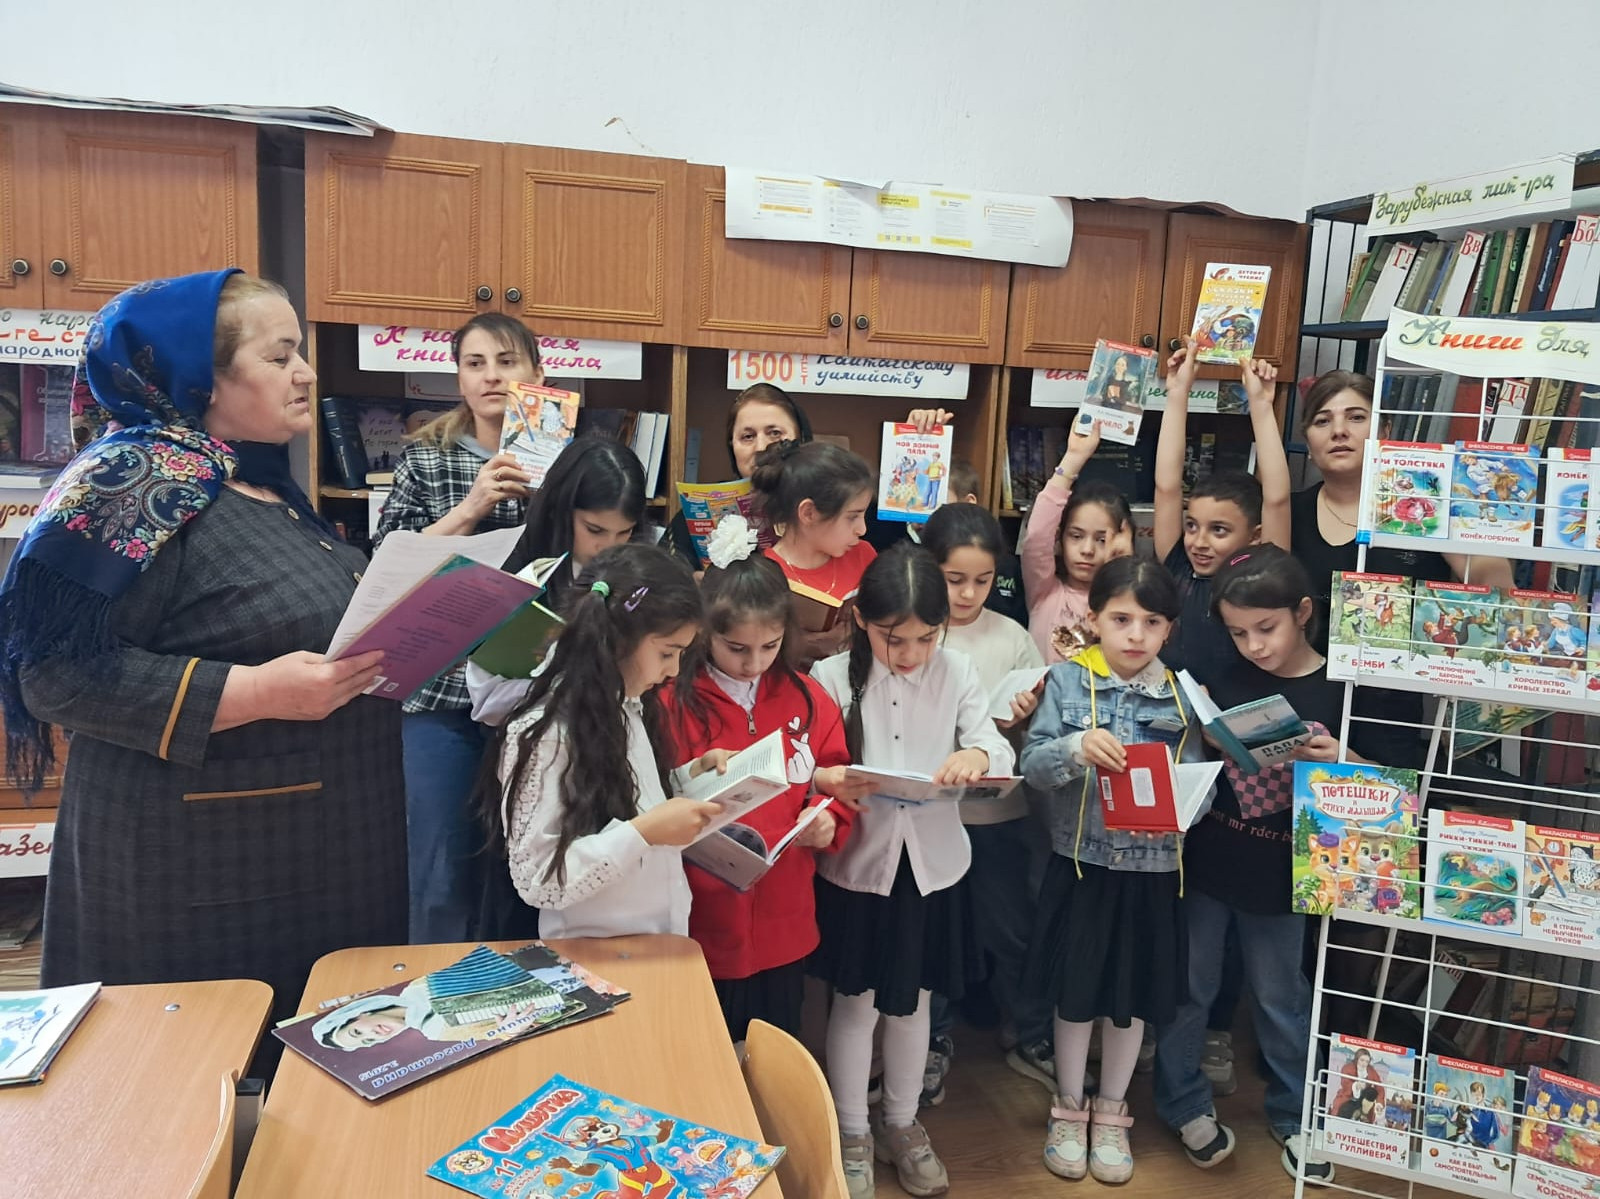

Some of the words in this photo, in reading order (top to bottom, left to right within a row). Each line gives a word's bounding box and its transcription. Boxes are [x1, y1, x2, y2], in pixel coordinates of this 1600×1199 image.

[1376, 185, 1472, 224] Зарубежная
[1461, 234, 1480, 256] Вв
[374, 325, 408, 346] К
[422, 330, 457, 343] на
[536, 336, 580, 351] ая
[1400, 318, 1523, 350] Книги
[730, 351, 793, 382] 1500
[1394, 459, 1445, 469] ТОЛСТЯКА
[1460, 533, 1520, 543] КОНЁК-ГОРБУНОК
[1352, 659, 1385, 669] БЕМБИ
[1428, 665, 1476, 675] ПРИКЛЮЧЕНИЯ
[1429, 677, 1473, 686] МЮНХАУЗЕНА
[1439, 672, 1464, 680] БАРОНА
[1514, 677, 1565, 687] КОРОЛЕВСТВО
[1508, 684, 1539, 692] КРИВЫХ
[1542, 687, 1571, 695] ЗЕРКАЛ
[1262, 739, 1304, 754] ПАПА
[1321, 786, 1390, 803] ПОТЕШКИ
[1322, 802, 1346, 814] СТИХИ
[1347, 807, 1387, 816] МАЛЫШАМ
[1439, 833, 1517, 849] РИККИ-ТИККИ-ТАВИ
[1543, 928, 1594, 940] НЕВЫУЧЕННЫХ
[1559, 924, 1583, 932] СТРАНЕ
[1555, 936, 1581, 945] УРОКОВ
[371, 1037, 478, 1088] Дагестана
[483, 1090, 581, 1152] Мишутка
[1335, 1132, 1398, 1153] ПУТЕШЕСТВИЯ
[1340, 1143, 1391, 1161] ГУЛЛИВЕРА
[495, 1158, 522, 1177] 11
[1449, 1158, 1461, 1166] КАК
[1434, 1162, 1497, 1181] САМОСТОЯТЕЛЬНЫМ
[1527, 1173, 1546, 1184] СЕМЬ
